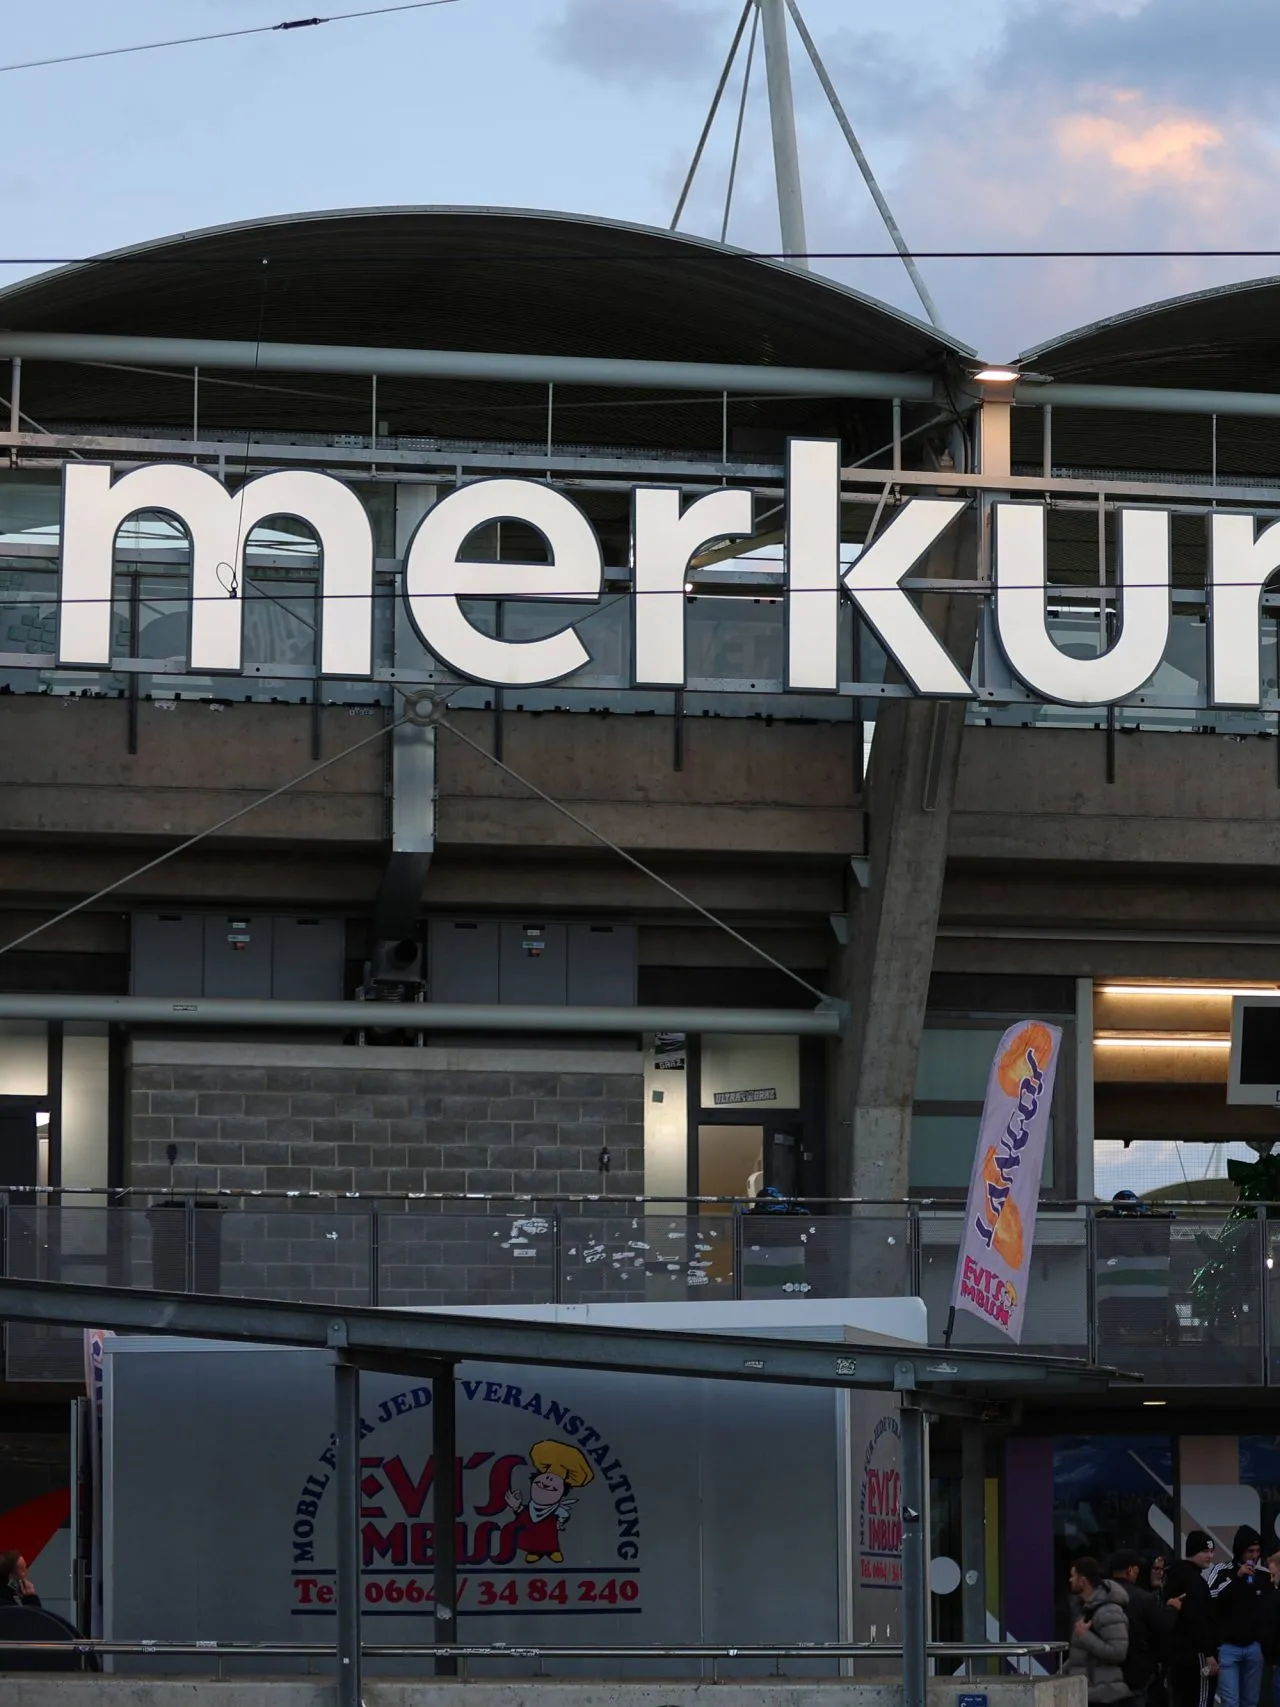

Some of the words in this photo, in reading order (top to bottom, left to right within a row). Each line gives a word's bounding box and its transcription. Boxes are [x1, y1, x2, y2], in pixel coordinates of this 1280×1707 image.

[292, 1472, 331, 1564] MOBIL
[318, 1416, 376, 1471] FR
[377, 1386, 433, 1424] JED
[461, 1380, 641, 1561] VERANSTALTUNG
[476, 1579, 519, 1606] 34
[526, 1578, 570, 1606] 84
[577, 1578, 641, 1606] 240
